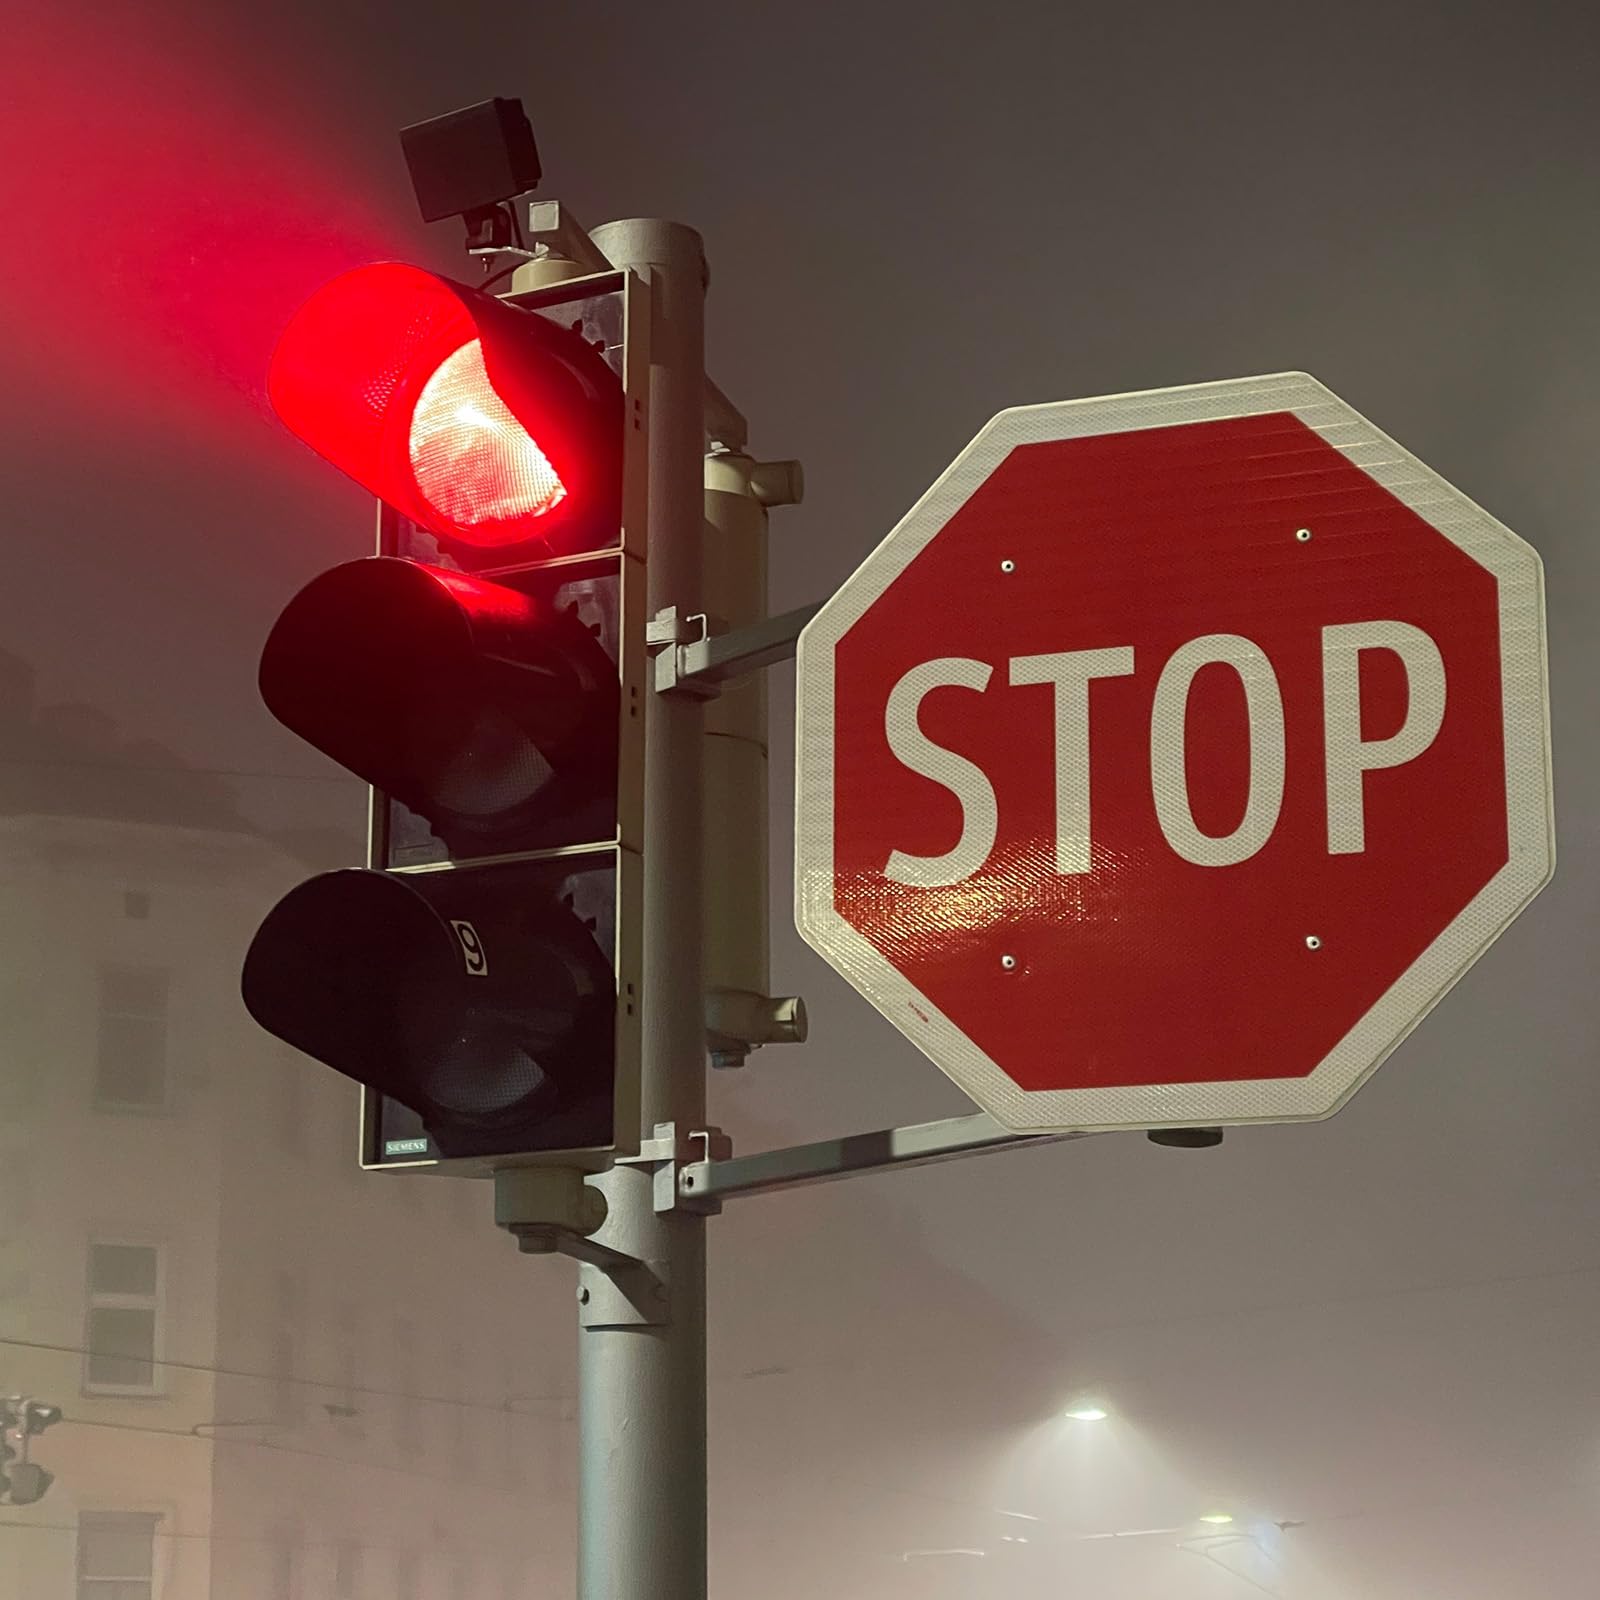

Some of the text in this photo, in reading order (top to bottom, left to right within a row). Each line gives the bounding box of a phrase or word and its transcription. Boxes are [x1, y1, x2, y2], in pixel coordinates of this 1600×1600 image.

[884, 620, 1447, 888] STOP
[457, 923, 484, 972] 9
[387, 1141, 425, 1153] SIEMENS
